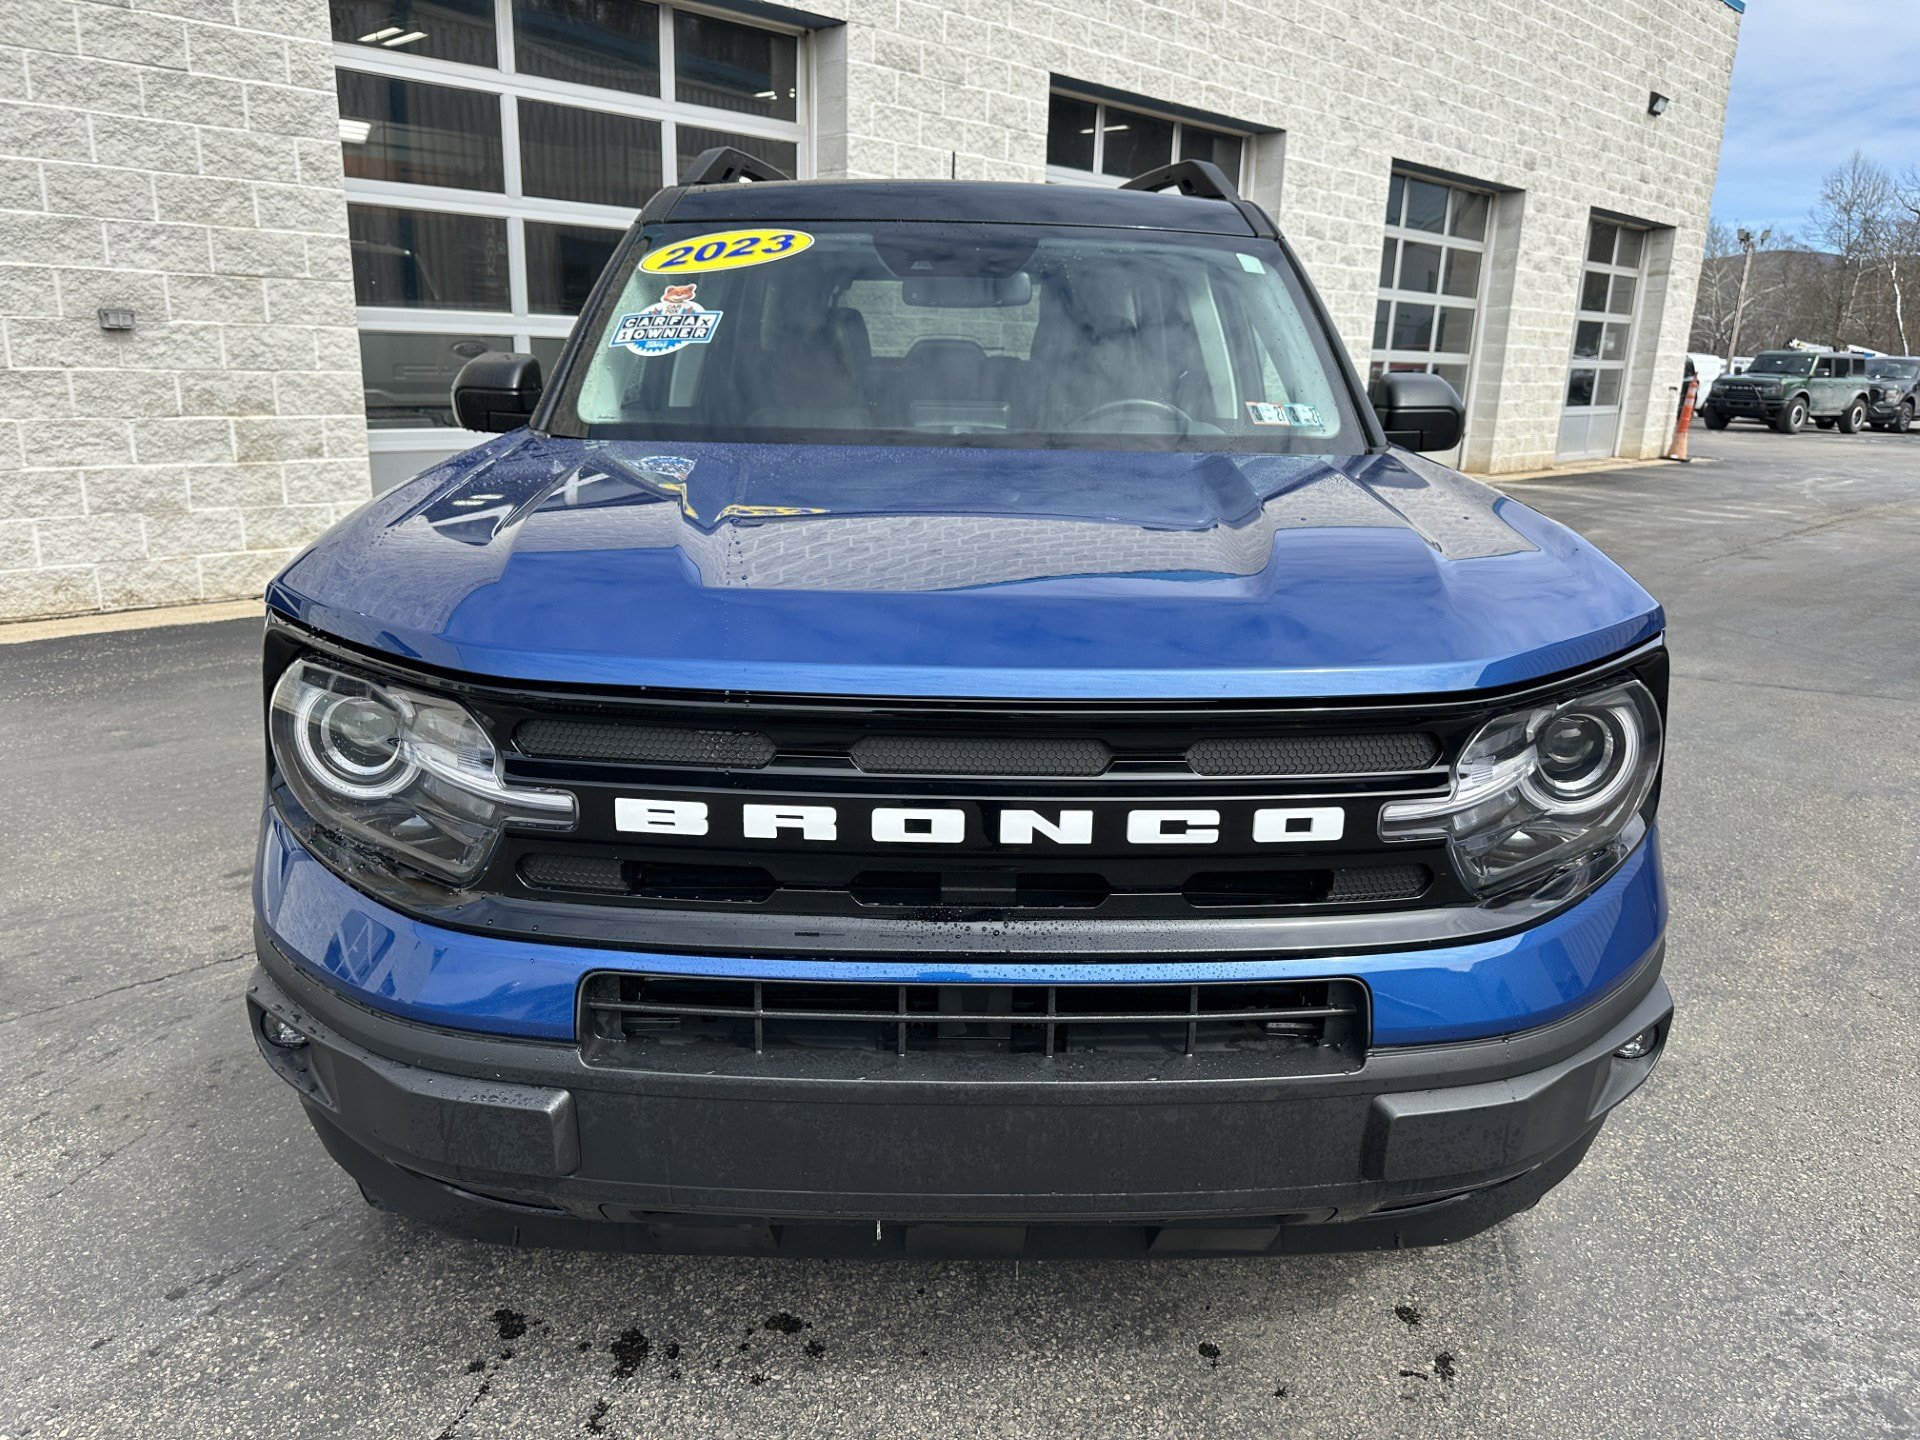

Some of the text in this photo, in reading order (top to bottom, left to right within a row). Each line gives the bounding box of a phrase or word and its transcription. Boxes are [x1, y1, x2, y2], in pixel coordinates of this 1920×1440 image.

[657, 234, 796, 269] 2023
[625, 315, 711, 328] CARFAX
[633, 328, 706, 338] OWNER
[614, 797, 1345, 845] BRONCO
